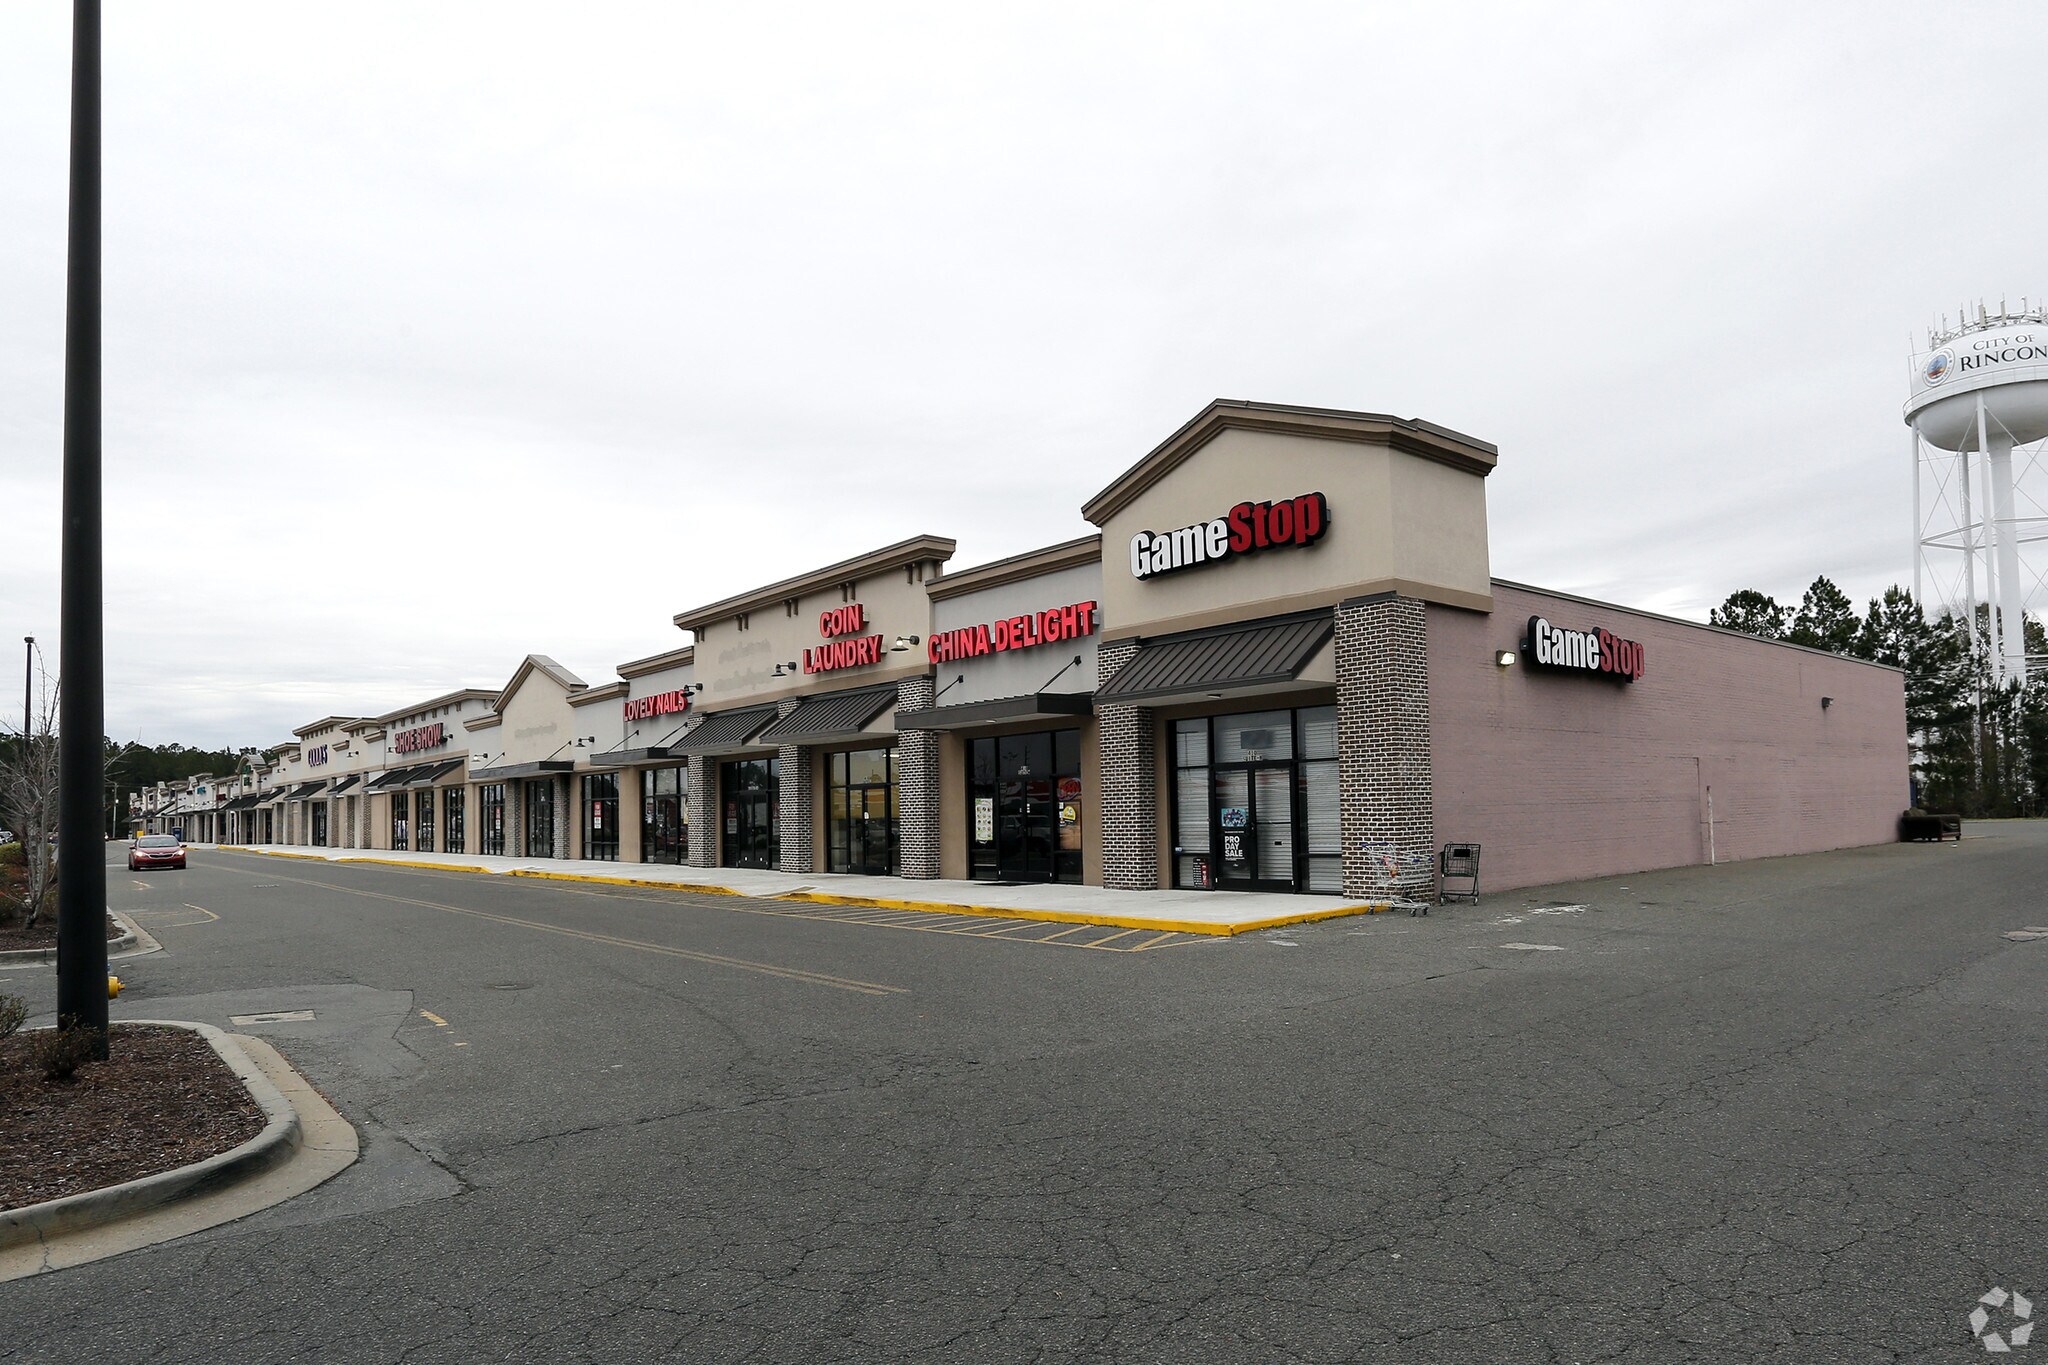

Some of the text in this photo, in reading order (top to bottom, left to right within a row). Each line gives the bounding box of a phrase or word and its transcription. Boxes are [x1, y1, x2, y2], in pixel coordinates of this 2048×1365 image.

[1960, 345, 2048, 372] RINCON
[1973, 333, 2036, 351] CITY OF
[1129, 491, 1323, 581] GameStop
[820, 603, 864, 638] COIN
[928, 600, 1098, 664] CHINA DELIGHT
[803, 634, 884, 675] LAUNDRY
[1535, 616, 1645, 682] GameStop
[624, 693, 655, 722] LOVELY
[656, 688, 688, 716] NAILS
[394, 722, 444, 754] SHOE SHOW
[1224, 835, 1240, 844] PRO
[1224, 849, 1243, 857] SALE
